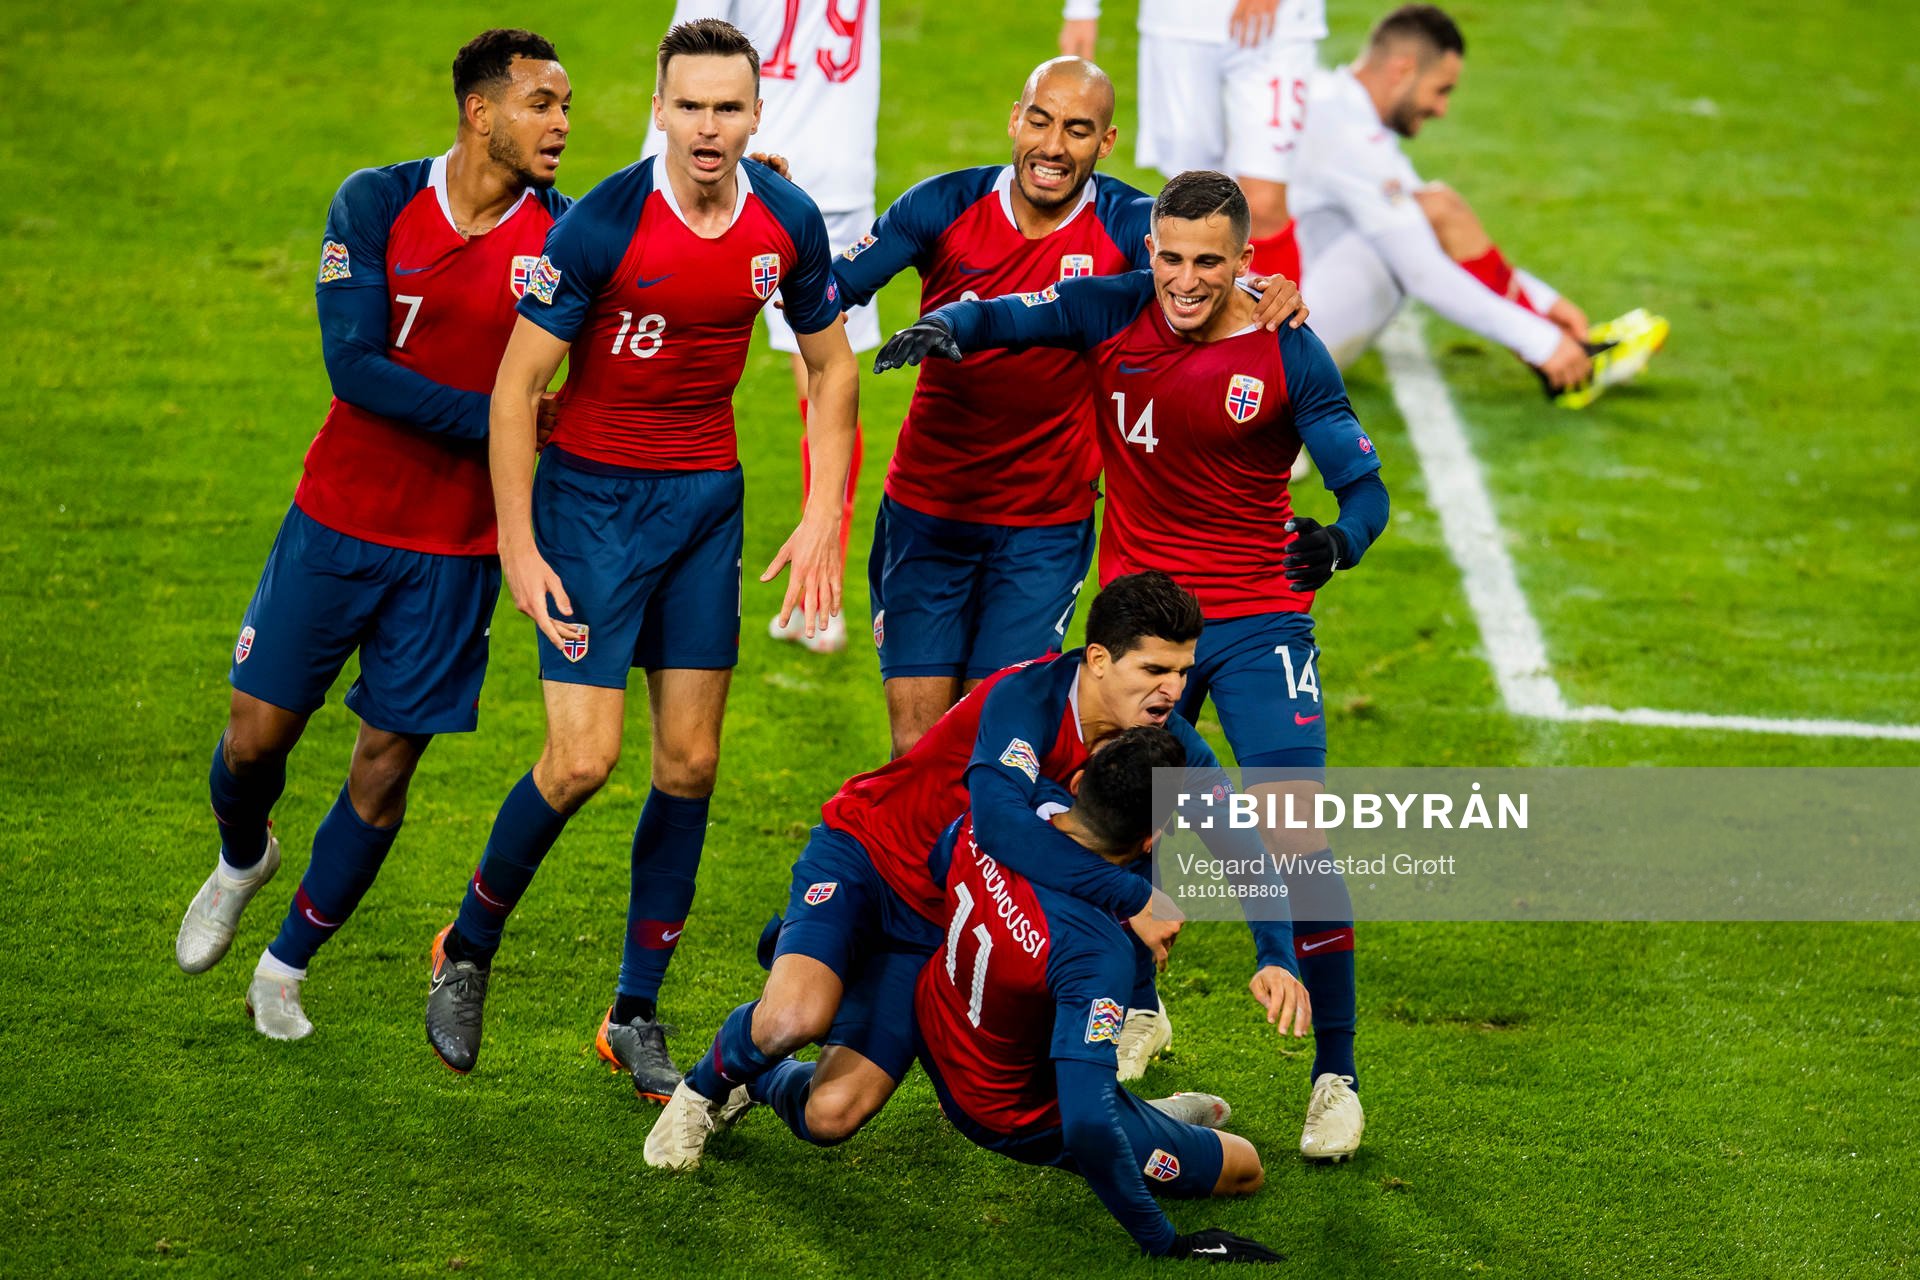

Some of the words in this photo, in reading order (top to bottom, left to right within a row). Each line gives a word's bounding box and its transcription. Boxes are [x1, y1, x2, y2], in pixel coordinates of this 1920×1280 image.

[759, 0, 868, 83] 19
[395, 293, 424, 348] 7
[610, 310, 666, 358] 18
[1110, 391, 1159, 453] 14
[1274, 645, 1319, 703] 14
[945, 881, 994, 1029] 11
